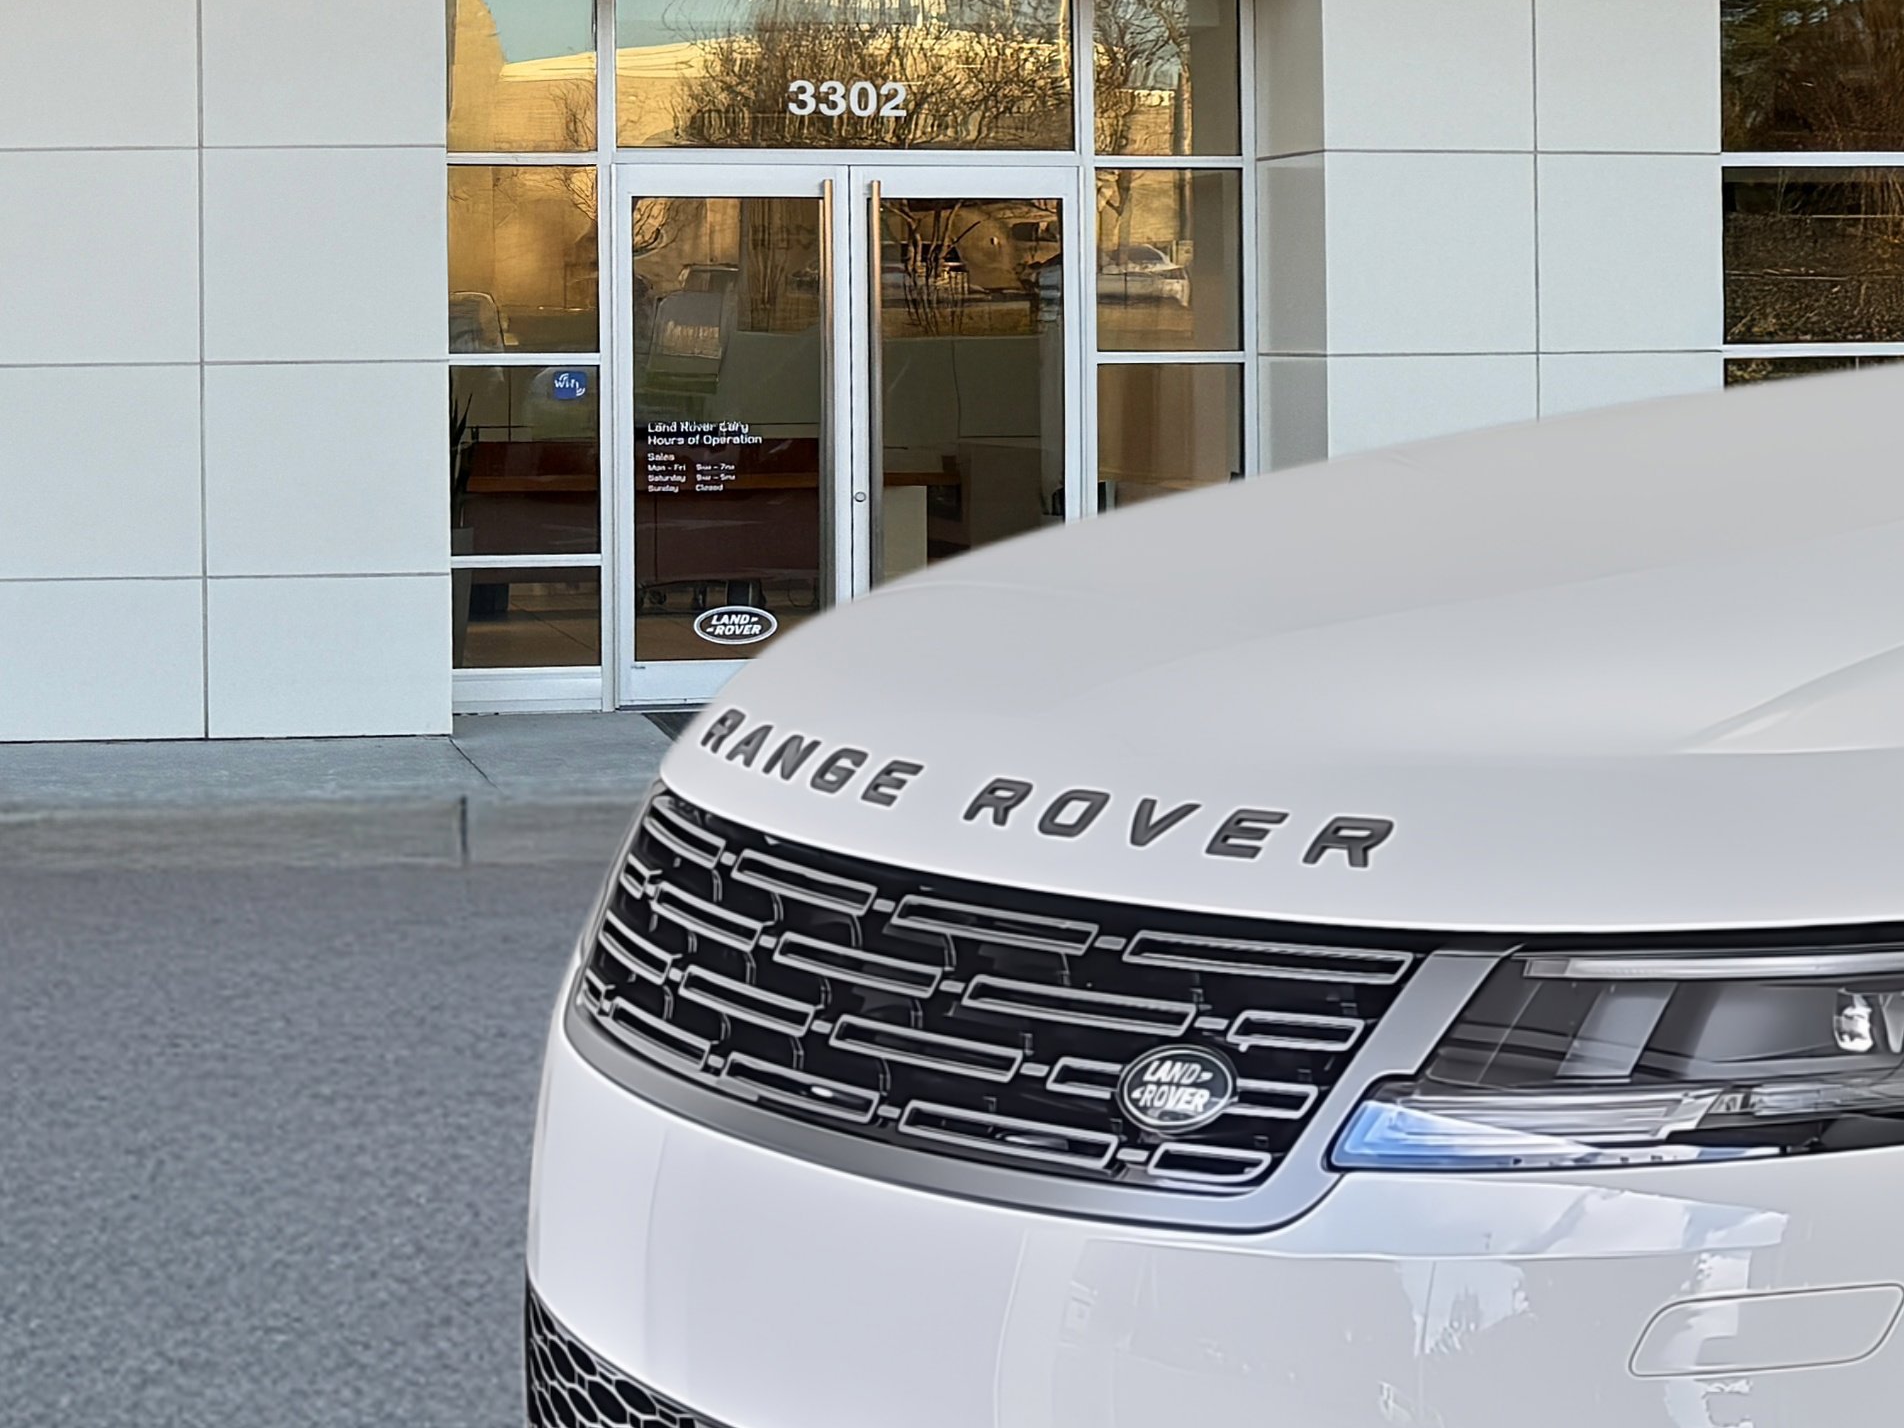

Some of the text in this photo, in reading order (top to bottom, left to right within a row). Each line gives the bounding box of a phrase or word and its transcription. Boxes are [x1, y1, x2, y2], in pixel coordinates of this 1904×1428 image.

[787, 79, 908, 118] 3302
[647, 434, 763, 447] Hours of Operation
[647, 452, 676, 461] Sales
[711, 614, 751, 625] LAND
[714, 624, 762, 636] ROVER
[699, 708, 1396, 870] RANGE ROVER
[1143, 1060, 1202, 1085] LAND
[1138, 1083, 1211, 1113] ROVER
